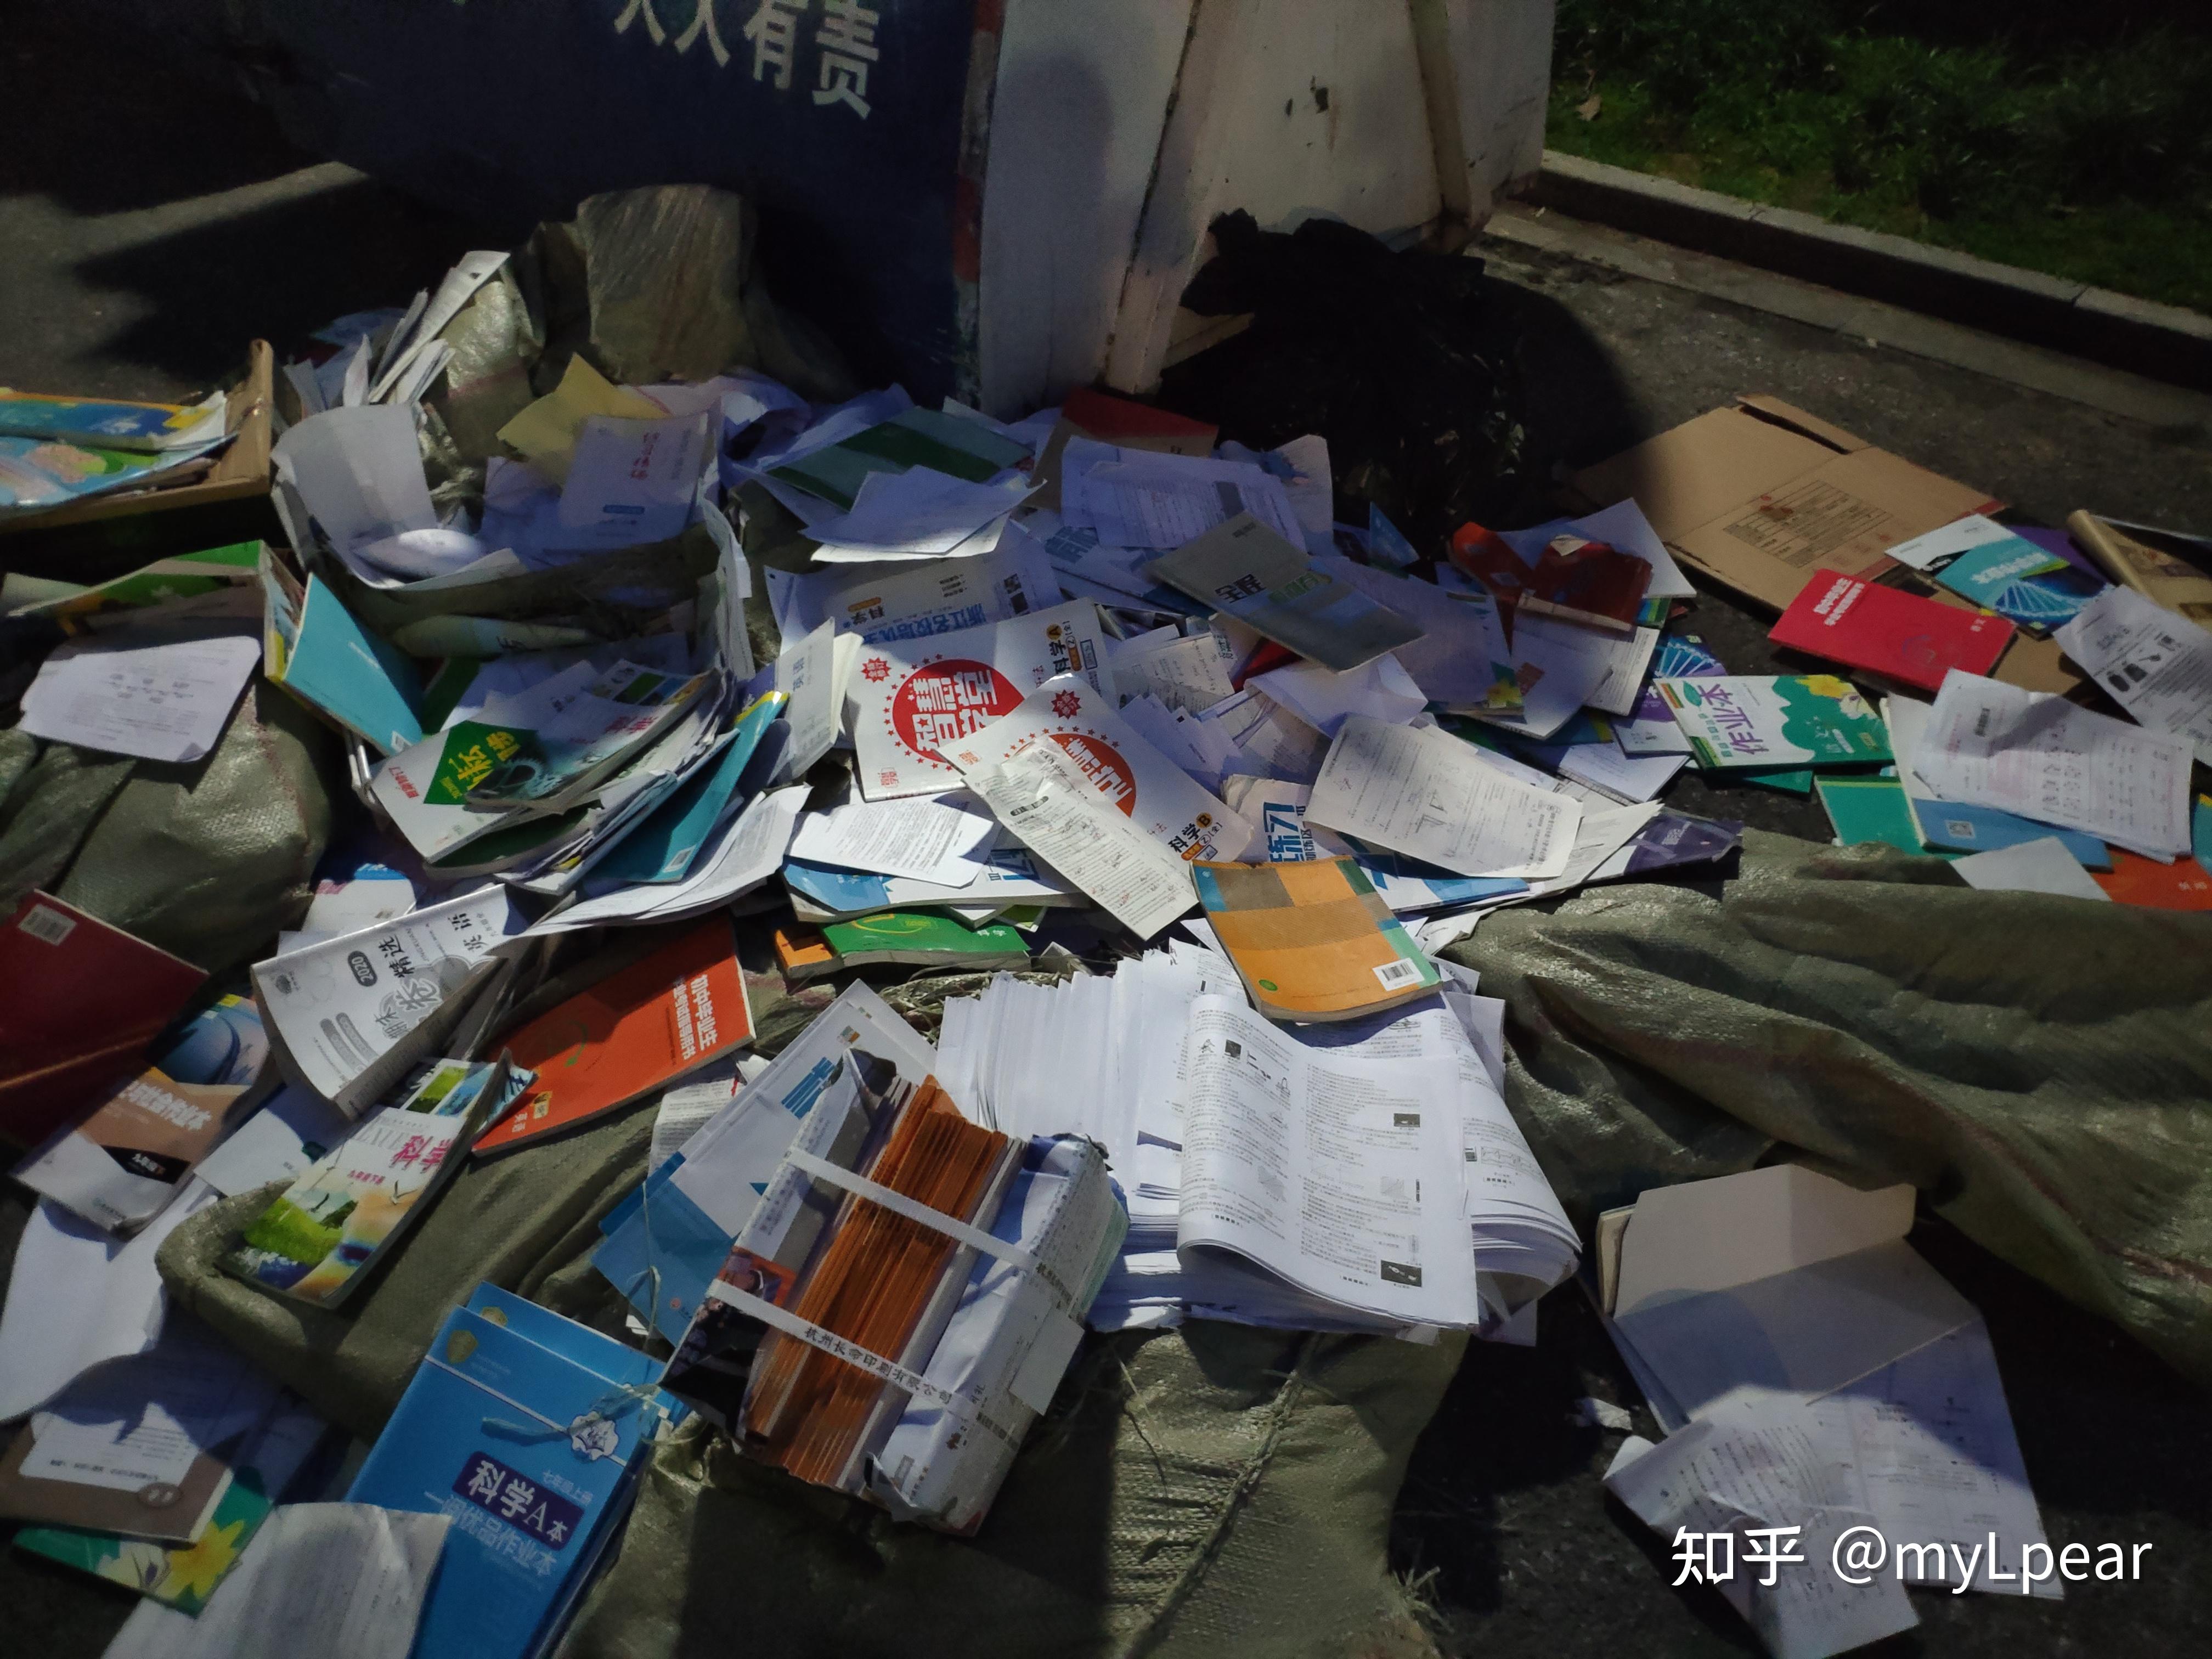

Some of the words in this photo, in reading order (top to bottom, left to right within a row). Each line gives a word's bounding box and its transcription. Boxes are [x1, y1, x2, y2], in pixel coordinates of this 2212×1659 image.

[1049, 641, 1070, 673] 科学
[1698, 683, 1769, 756] 作业本
[1167, 825, 1199, 852] 科学
[447, 913, 489, 952] 英语
[351, 956, 373, 984] 2020
[378, 934, 415, 978] 精选
[690, 974, 718, 1049] 初中毕业生
[467, 1460, 569, 1542] 科学A本
